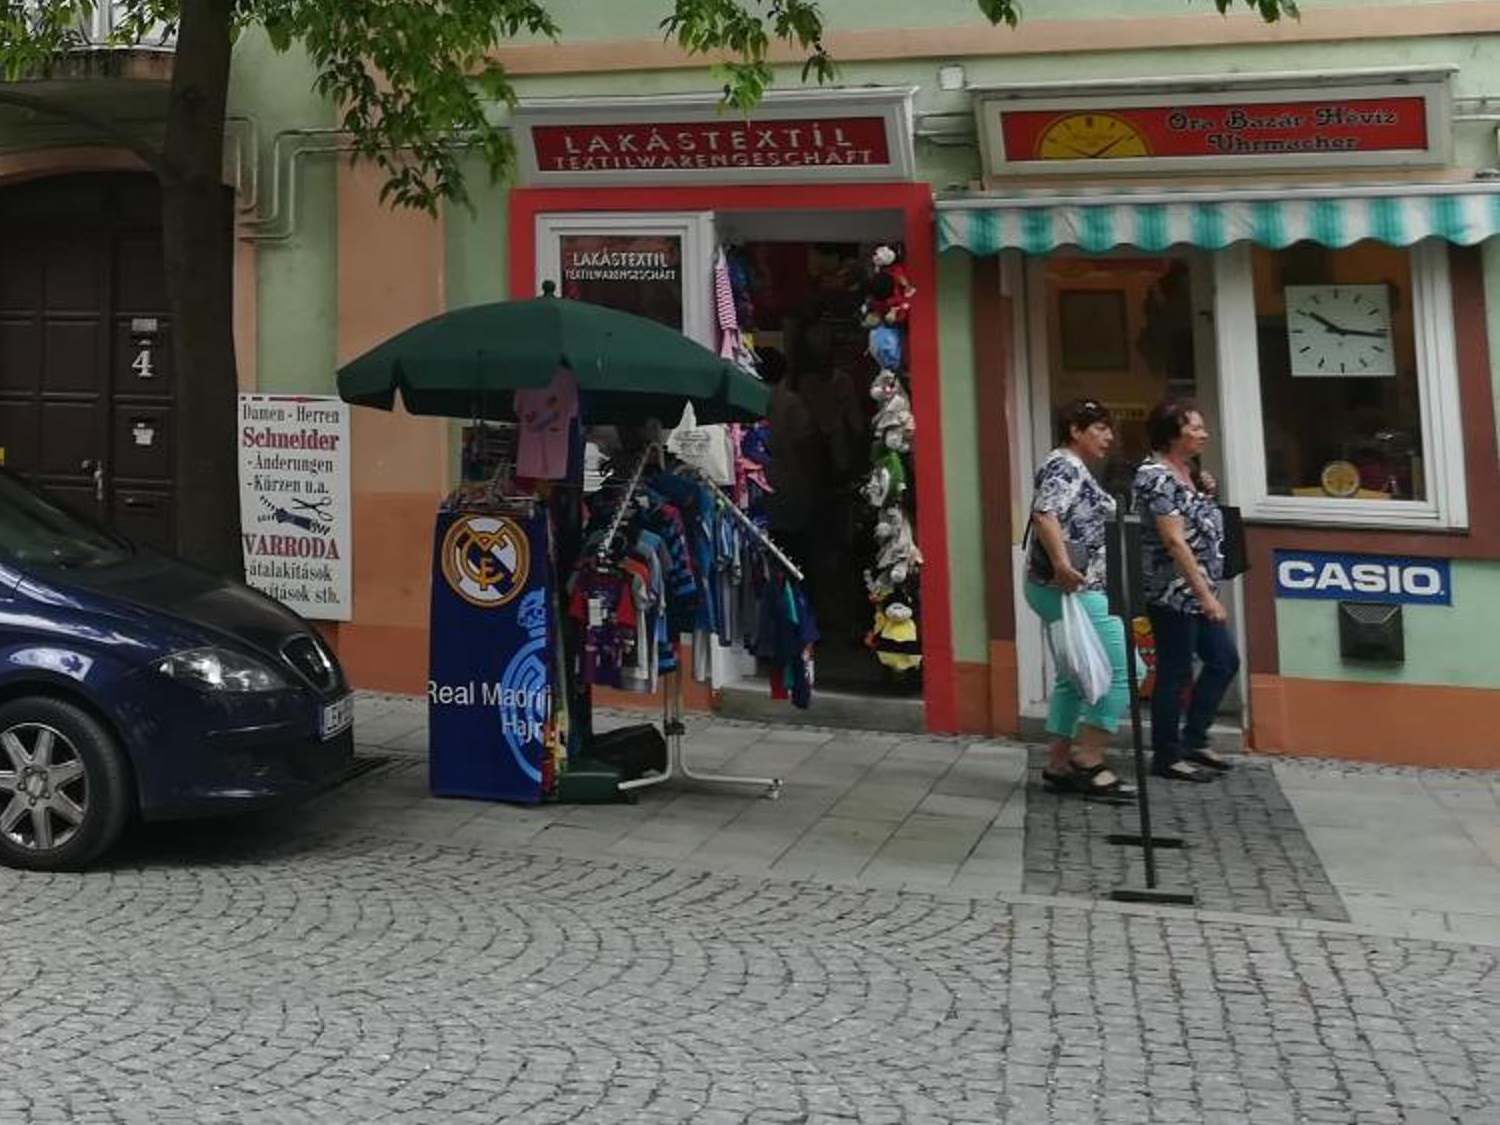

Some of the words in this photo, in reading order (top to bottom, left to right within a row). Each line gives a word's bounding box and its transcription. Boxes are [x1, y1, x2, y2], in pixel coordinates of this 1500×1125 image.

[132, 350, 153, 377] 4
[243, 404, 285, 421] Damen
[297, 405, 340, 423] Herren
[243, 426, 340, 450] Schneider
[243, 534, 340, 560] VARRODA
[1278, 560, 1445, 595] CASIO
[428, 681, 475, 705] Real
